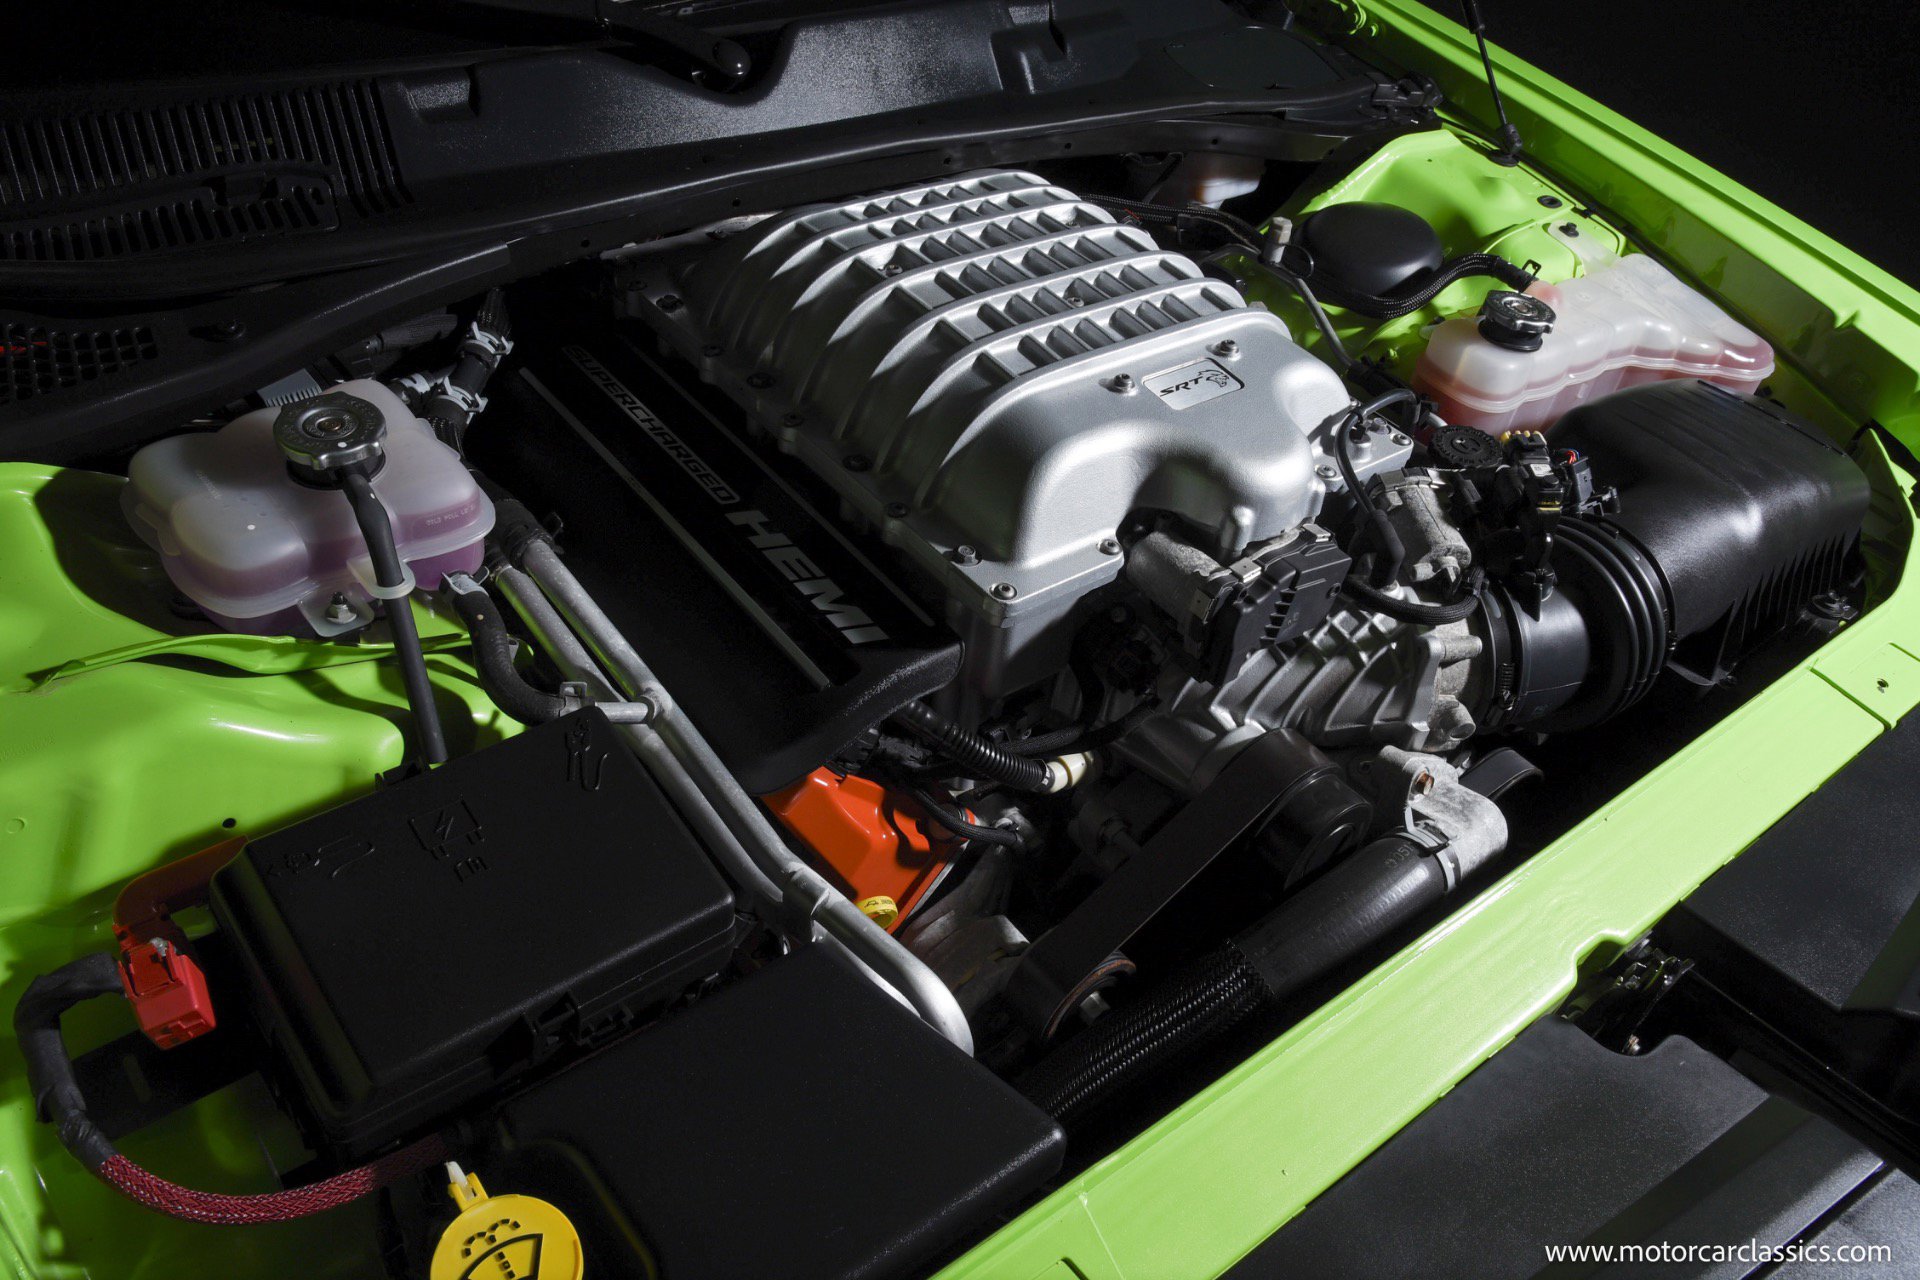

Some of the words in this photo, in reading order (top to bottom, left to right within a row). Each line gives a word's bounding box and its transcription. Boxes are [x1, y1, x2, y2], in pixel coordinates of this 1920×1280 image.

[563, 346, 736, 502] SUPERCHARGED
[1159, 376, 1204, 397] SRT
[724, 510, 890, 645] HEMI
